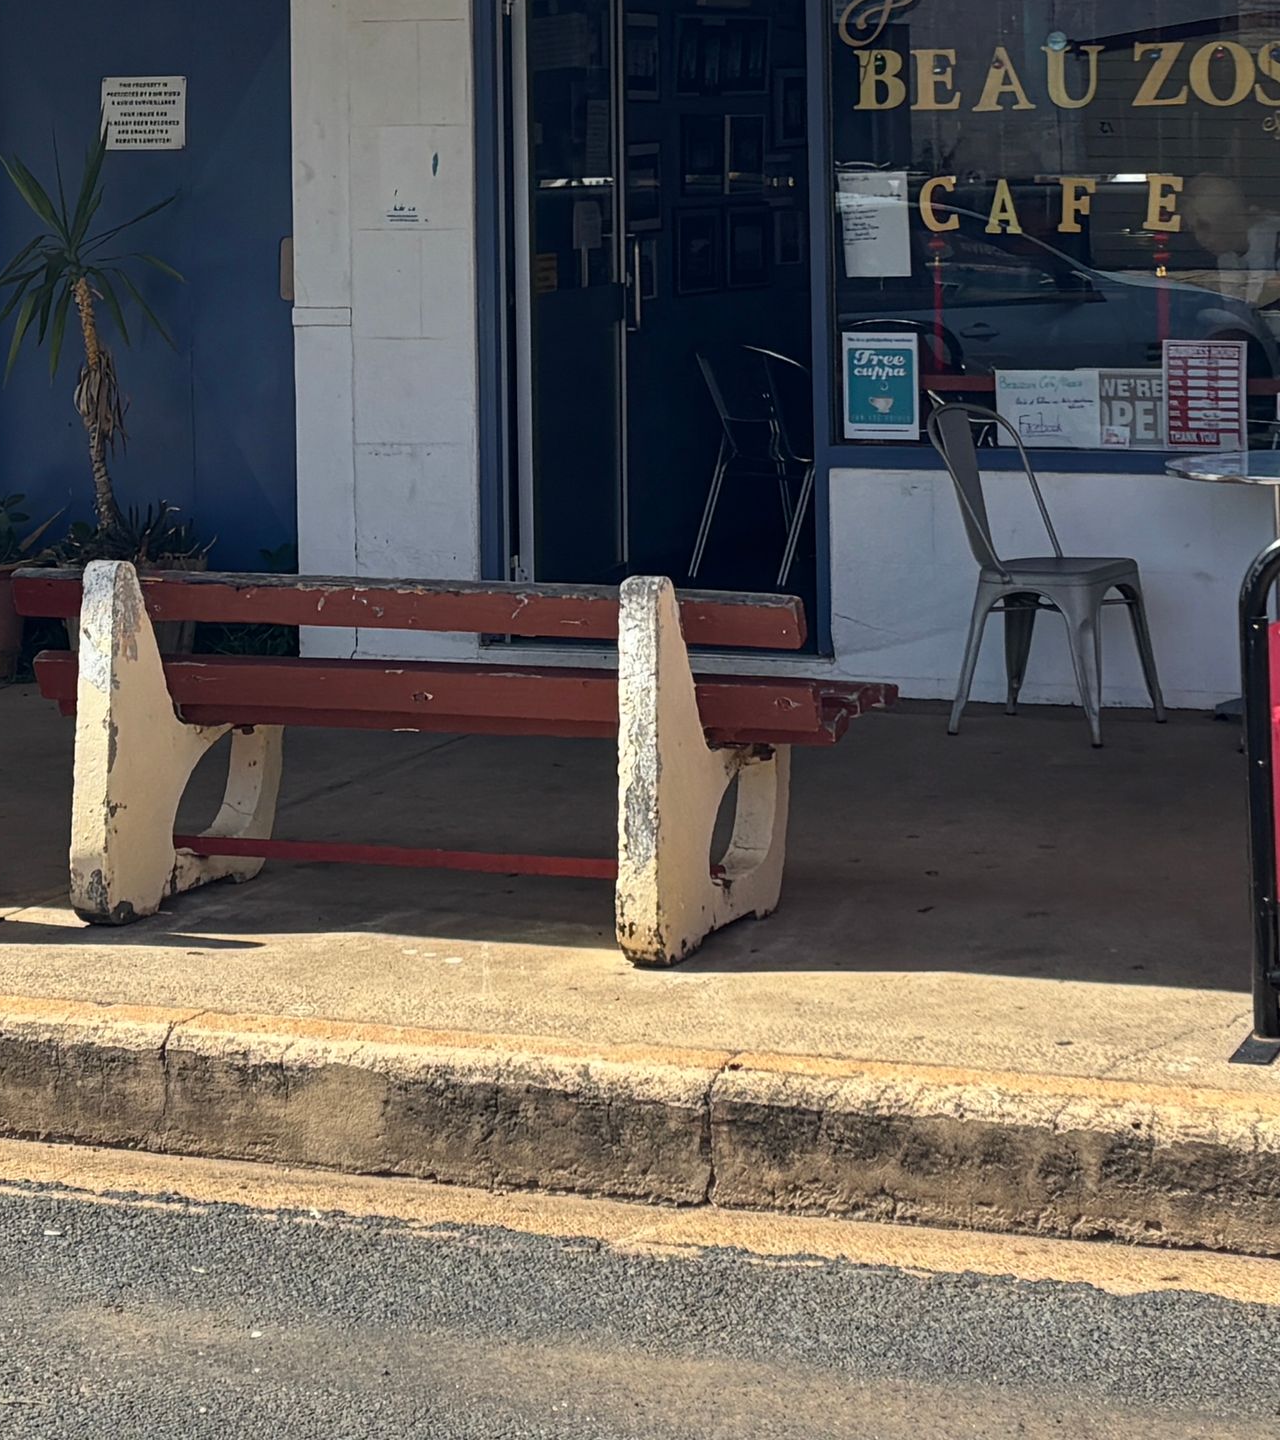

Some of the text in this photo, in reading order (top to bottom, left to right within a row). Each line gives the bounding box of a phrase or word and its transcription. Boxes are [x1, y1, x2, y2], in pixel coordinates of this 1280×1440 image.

[853, 44, 1106, 112] BEAU
[918, 172, 1185, 236] CAFE
[853, 349, 906, 366] Free
[853, 365, 906, 380] cuppa
[1101, 378, 1162, 397] WE'RE
